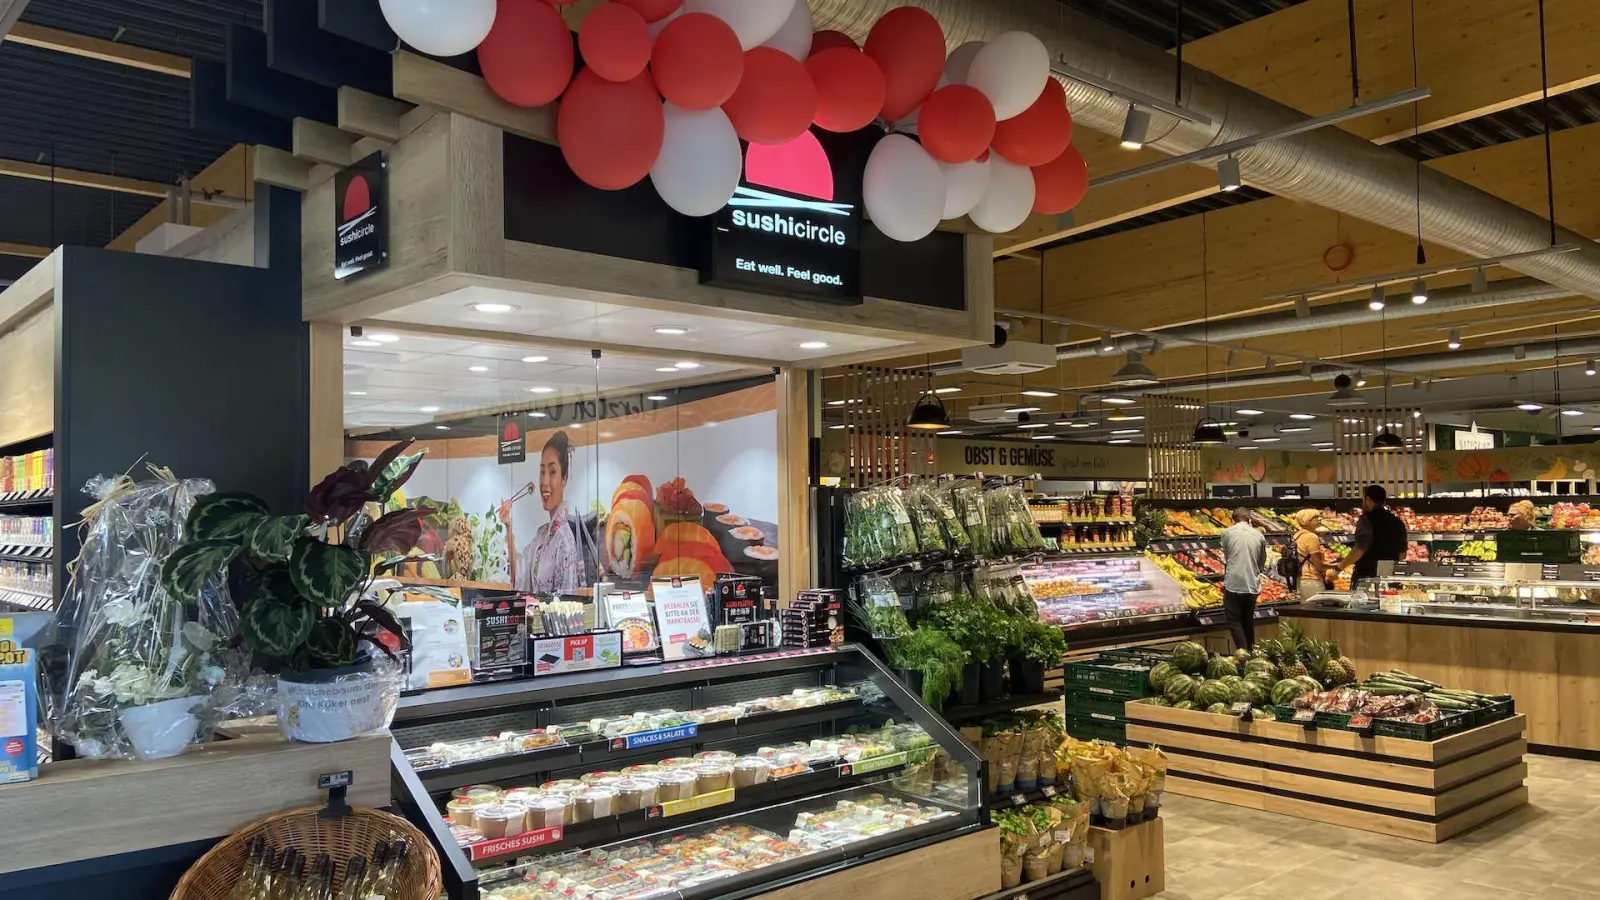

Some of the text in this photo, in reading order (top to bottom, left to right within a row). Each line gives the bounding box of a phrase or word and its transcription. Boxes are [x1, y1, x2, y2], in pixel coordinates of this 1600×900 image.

[340, 223, 375, 247] sushicircle
[732, 209, 846, 246] sushicircle
[735, 258, 843, 286] Eat well. Feel good.
[964, 444, 1055, 467] OBST & GEMÜSE
[633, 734, 658, 745] SNACKS
[663, 729, 685, 740] SALATE
[862, 759, 894, 770] VEGETARISCH
[482, 834, 545, 855] FRISCHES SUSHI
